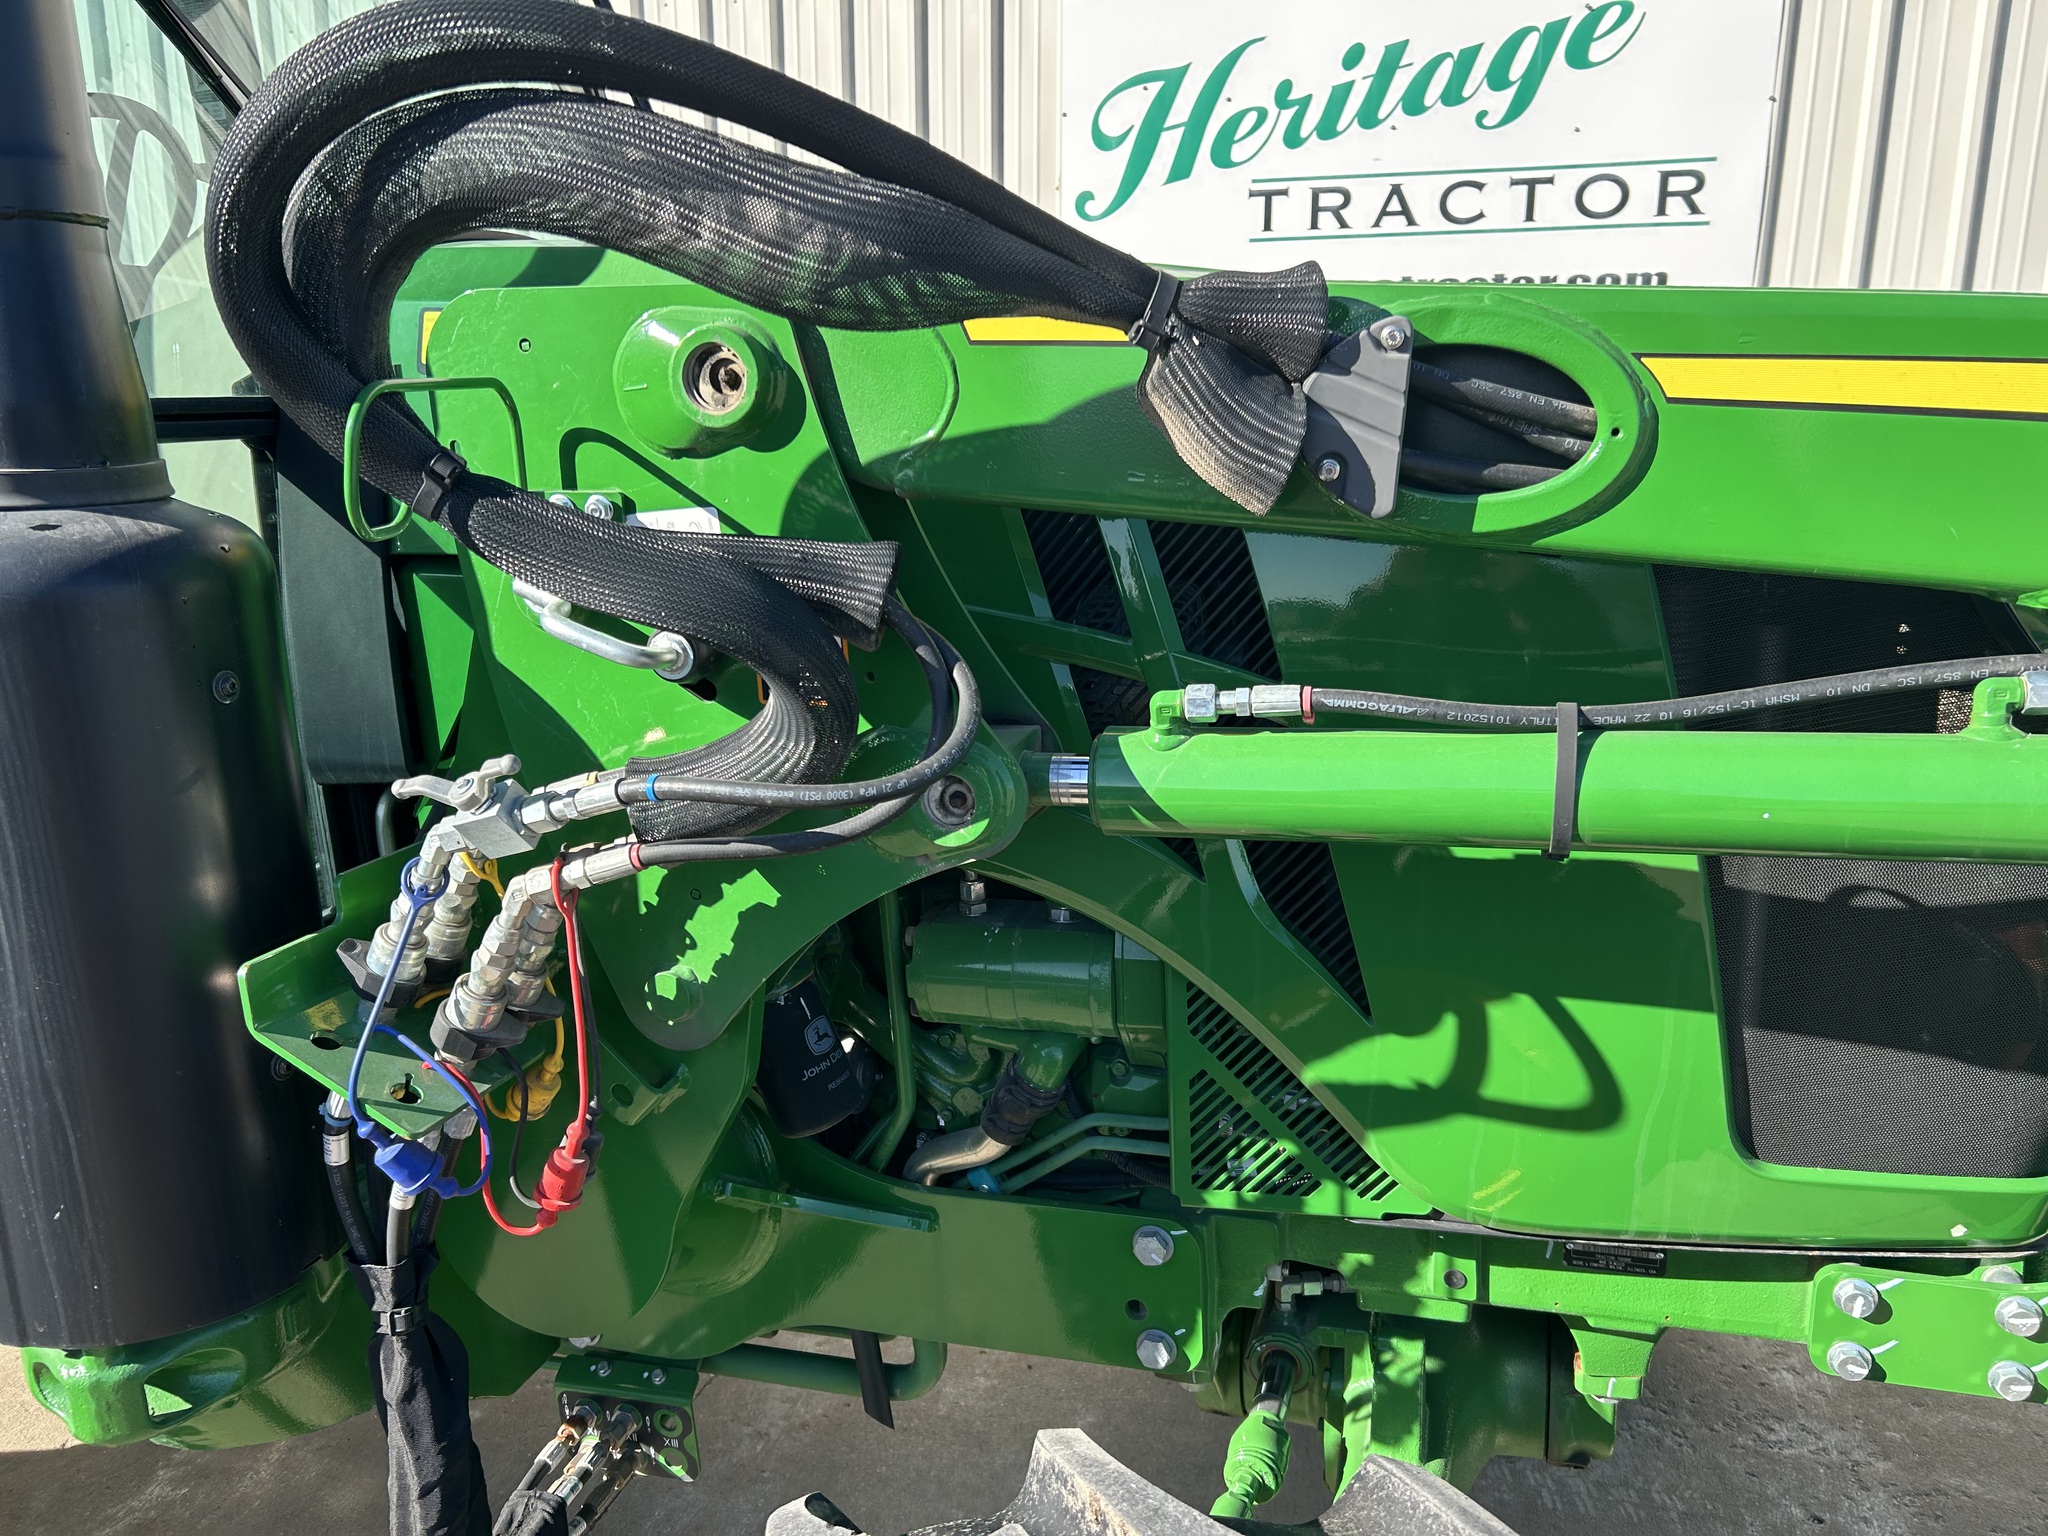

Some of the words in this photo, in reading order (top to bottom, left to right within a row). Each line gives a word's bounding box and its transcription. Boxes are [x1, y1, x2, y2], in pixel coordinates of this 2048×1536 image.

[1076, 0, 1646, 221] Heritage
[1248, 168, 1709, 232] TRACTOR
[1529, 396, 1545, 406] EN
[1934, 672, 1962, 683] 857
[1970, 669, 1989, 679] EN
[1826, 687, 1841, 697] 10
[1852, 682, 1871, 693] DN
[1765, 693, 1801, 706] MSHA
[1320, 698, 1417, 716] ALFAGOMMA
[1594, 715, 1627, 725] MADE
[1634, 713, 1650, 723] 22
[755, 789, 795, 799] exceeds
[800, 790, 822, 801] PSI)
[826, 789, 853, 801] (3000
[859, 786, 877, 797] MPa
[802, 1058, 830, 1081] JOHN
